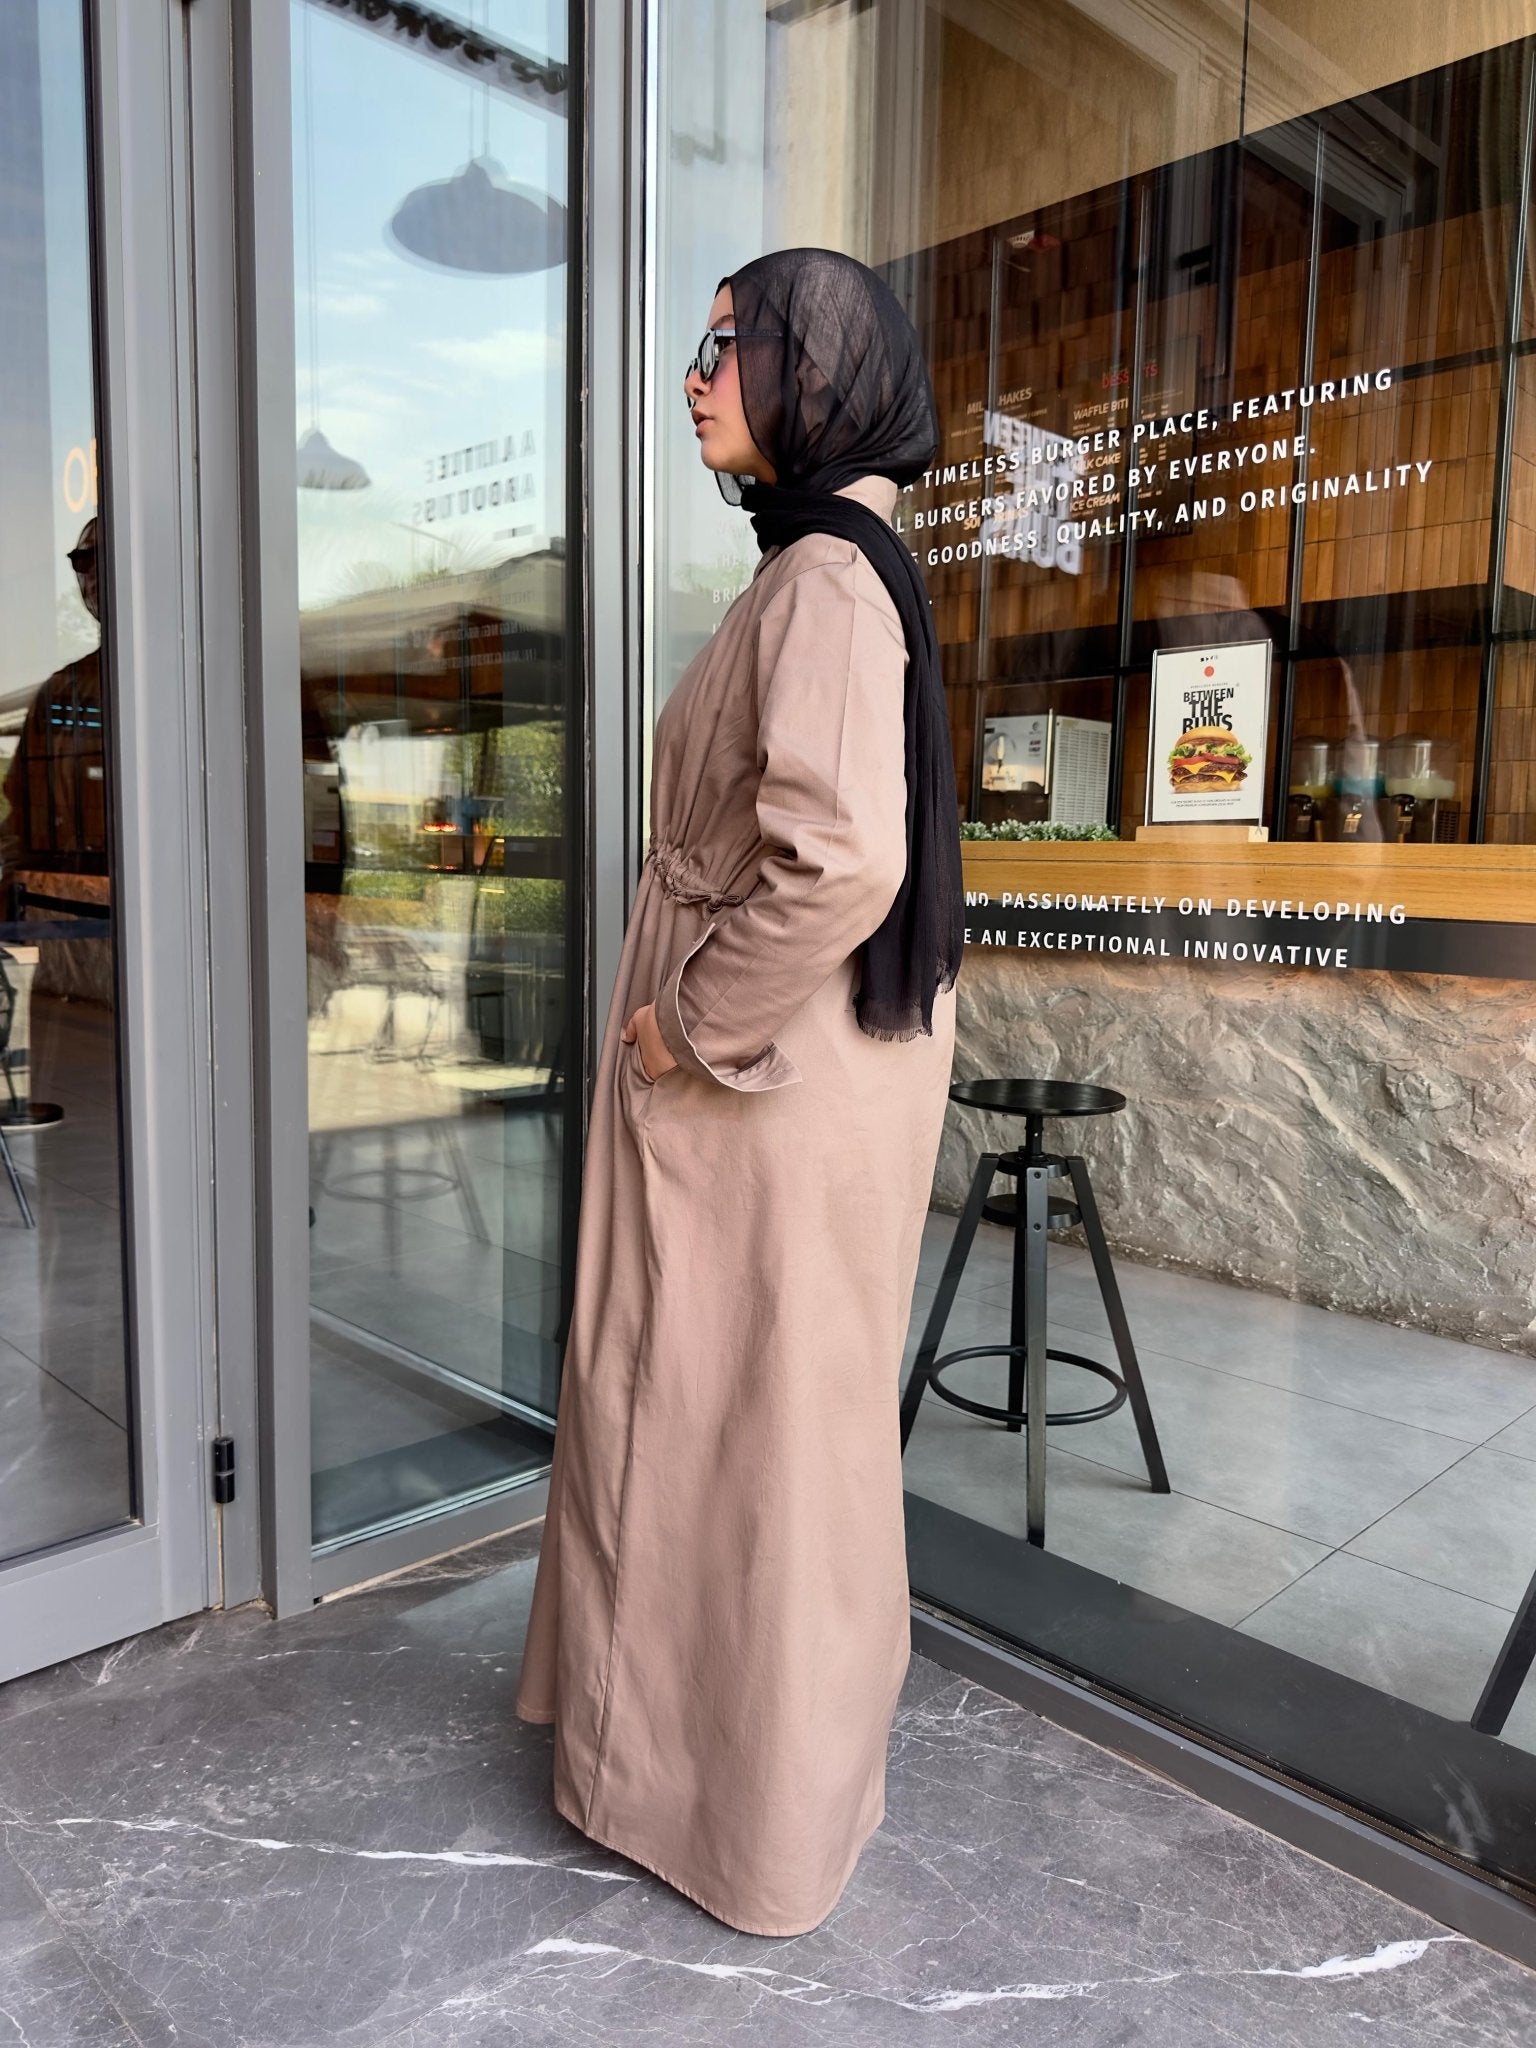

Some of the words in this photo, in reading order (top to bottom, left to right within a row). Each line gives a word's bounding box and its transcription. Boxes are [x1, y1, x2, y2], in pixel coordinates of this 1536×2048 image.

[1073, 403, 1110, 420] WAFFLE
[922, 452, 1020, 489] TIMELESS
[1031, 429, 1120, 465] BURGER
[1133, 409, 1218, 444] PLACE,
[1232, 368, 1392, 422] FEATURING
[1095, 452, 1121, 467] CAKE
[914, 496, 1005, 530] BURGERS
[1016, 473, 1115, 510] FAVORED
[1128, 465, 1157, 488] BY
[1170, 435, 1315, 480] EVERYONE.
[1070, 501, 1085, 512] ICE
[1086, 492, 1120, 509] CREAM
[927, 530, 1037, 566] GOODNESS
[1056, 508, 1163, 544] QUALITY,
[1175, 496, 1226, 524] AND
[1241, 461, 1433, 512] ORIGINALITY
[1183, 687, 1235, 703] BETWEEN
[1189, 697, 1224, 719] THE
[1182, 713, 1233, 735] BUNS
[965, 890, 989, 907] ND
[1002, 892, 1167, 914] PASSIONATELY
[1178, 897, 1213, 916] ON
[1226, 900, 1407, 925] DEVELOPING
[981, 929, 1007, 946] AN
[1017, 931, 1171, 957] EXCEPTIONAL
[1183, 940, 1348, 969] INNOVATIVE
